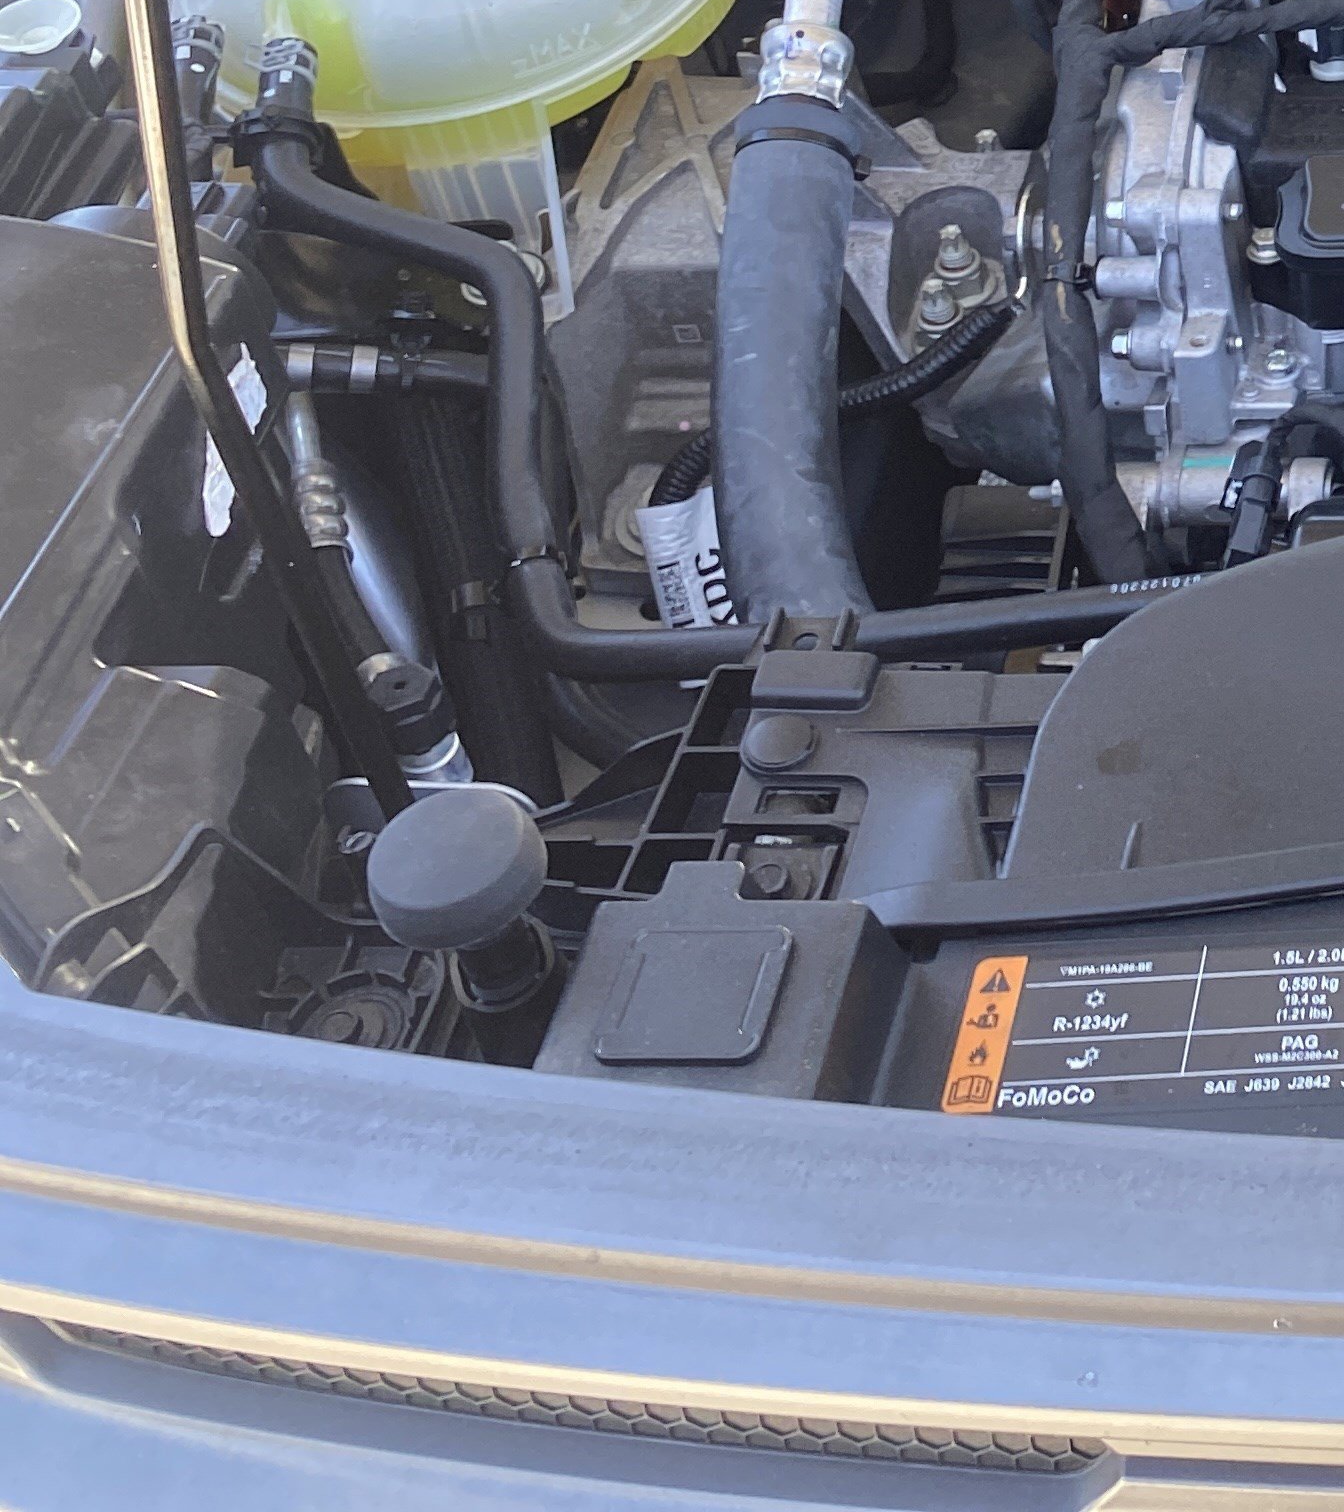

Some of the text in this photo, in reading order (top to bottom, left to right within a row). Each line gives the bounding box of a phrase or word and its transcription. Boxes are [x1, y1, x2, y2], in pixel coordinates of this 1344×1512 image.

[1273, 950, 1304, 965] 1.5L
[1278, 975, 1340, 993] 0.550 kg
[1284, 993, 1327, 1006] 19.4 oz
[1053, 1013, 1129, 1032] R-1234yf
[1276, 1006, 1333, 1024] (1.21 lbs)
[1281, 1034, 1319, 1051] PAG
[1204, 1080, 1237, 1094] SAE
[1244, 1077, 1280, 1093] J639
[1288, 1075, 1331, 1090] J2842
[998, 1085, 1095, 1108] FoMoCo
